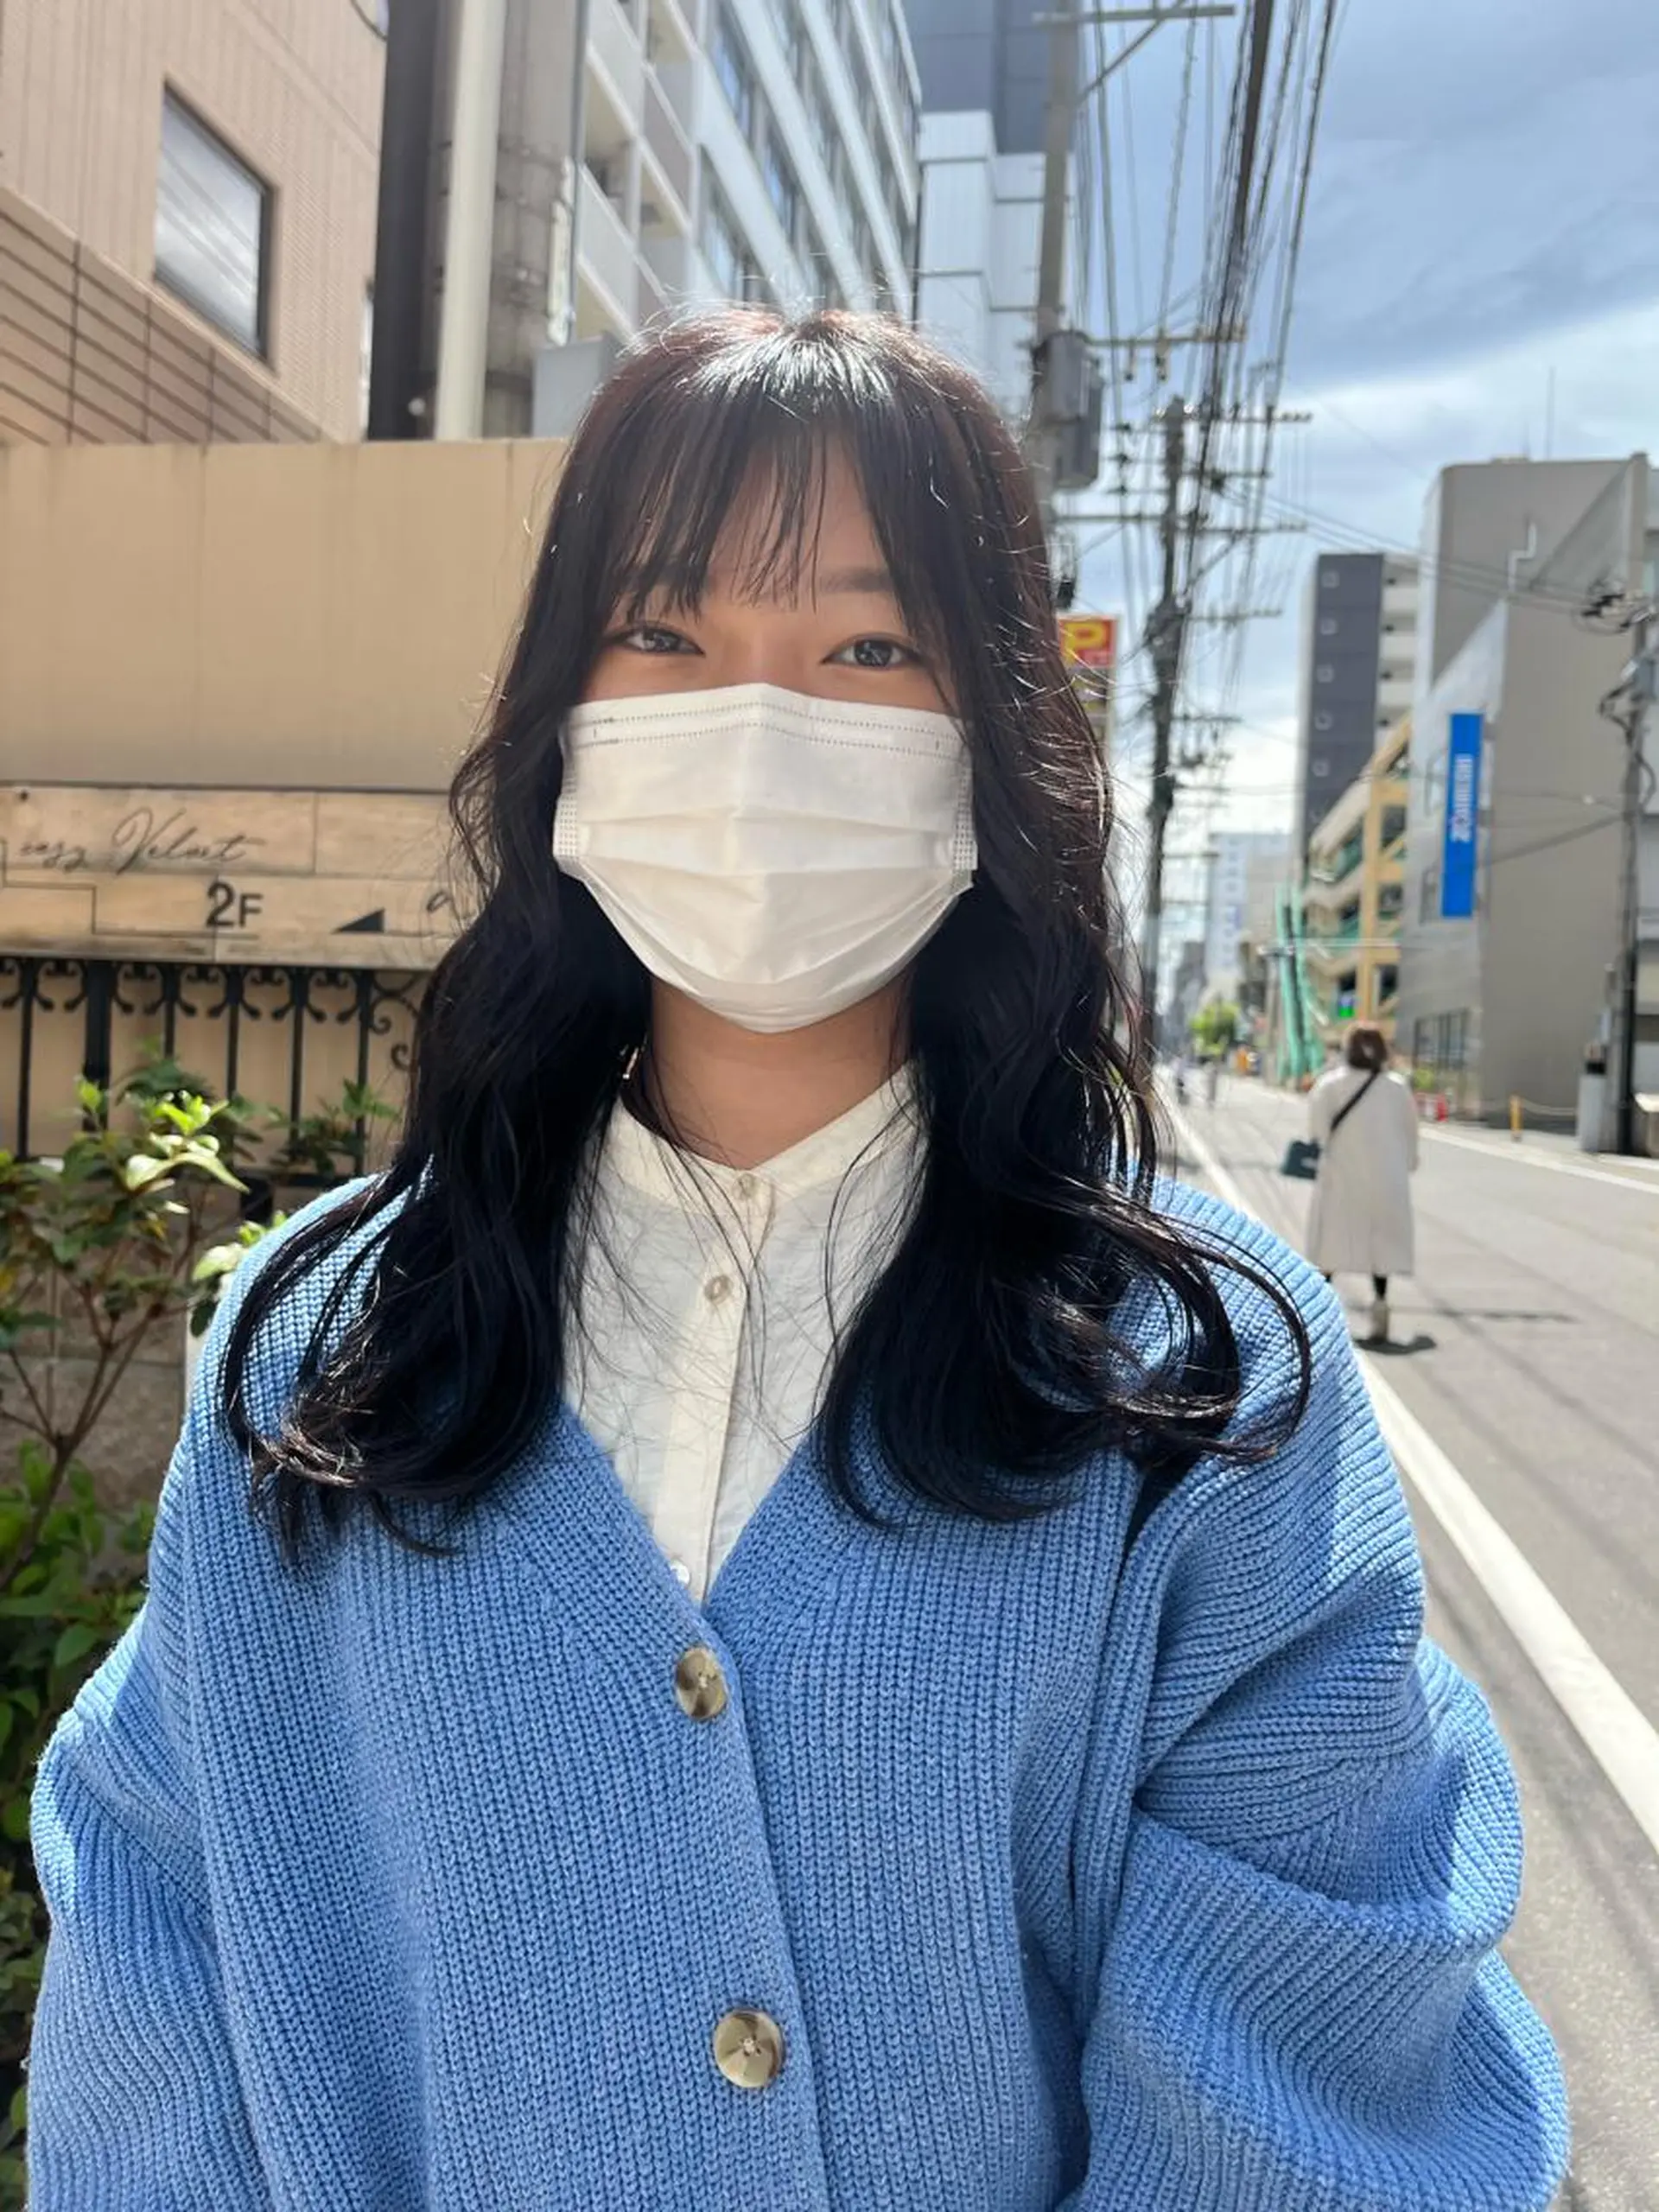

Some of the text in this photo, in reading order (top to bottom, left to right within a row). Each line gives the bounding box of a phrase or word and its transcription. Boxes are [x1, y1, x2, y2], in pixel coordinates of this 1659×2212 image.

[1064, 621, 1107, 664] P
[111, 806, 267, 876] Velvet
[206, 880, 264, 928] 2F
